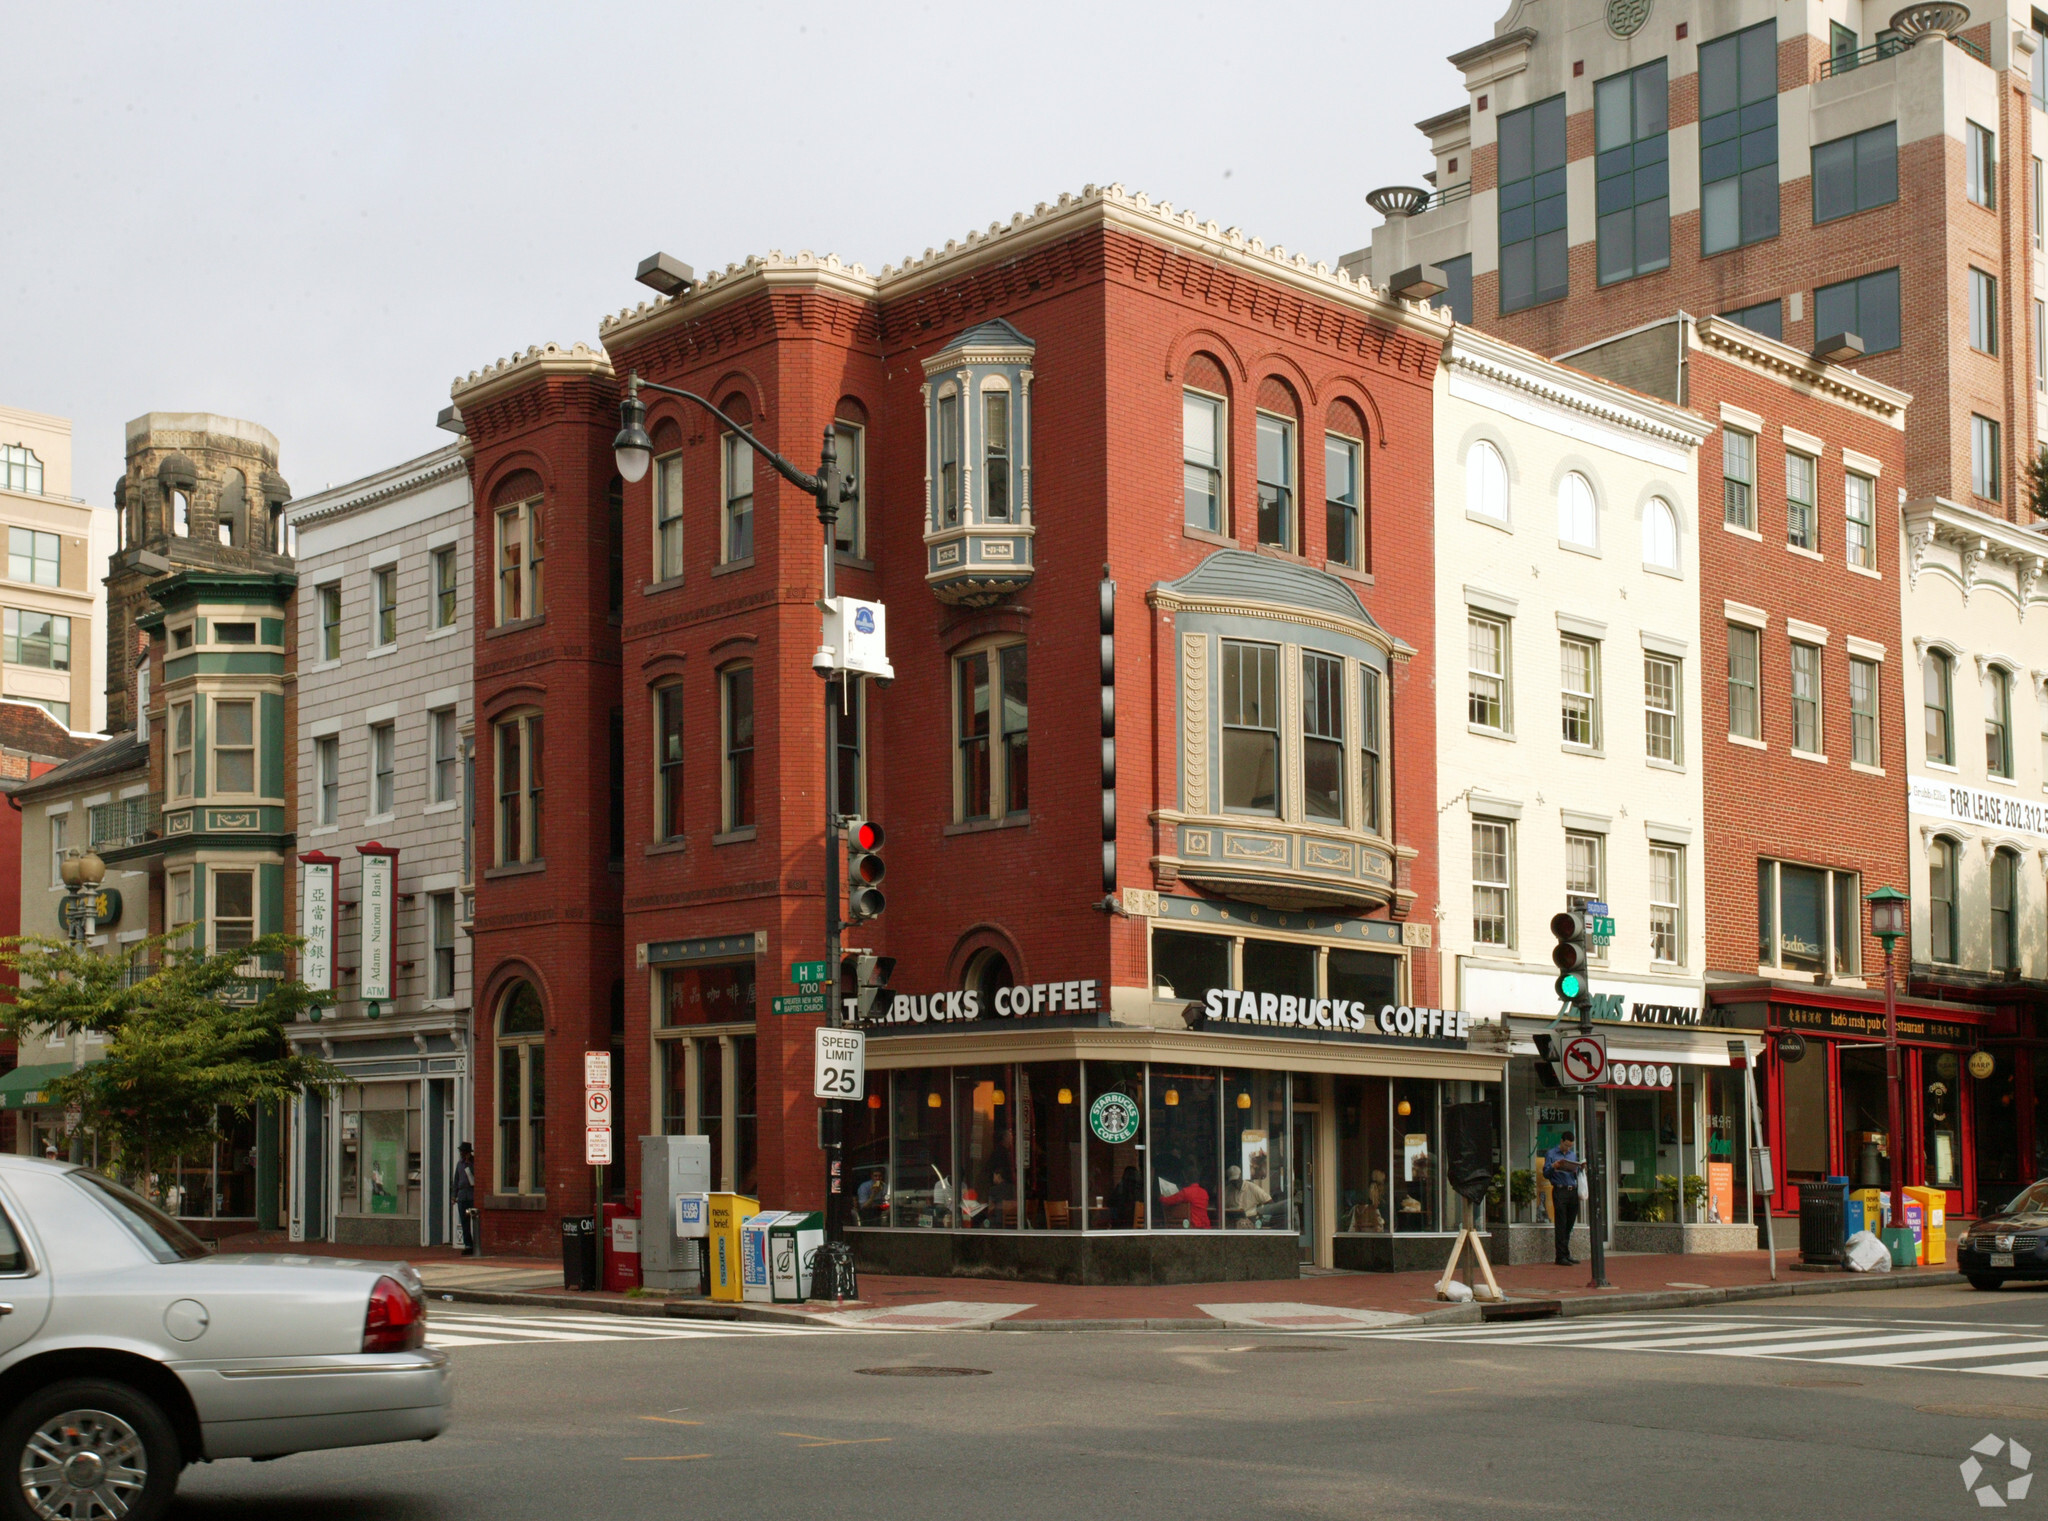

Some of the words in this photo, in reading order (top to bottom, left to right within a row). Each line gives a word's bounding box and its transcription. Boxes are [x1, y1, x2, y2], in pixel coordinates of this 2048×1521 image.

[1950, 788, 1970, 818] FOR
[1972, 793, 2002, 825] LEASE
[371, 873, 381, 897] Bank
[371, 903, 381, 942] National
[1596, 919, 1603, 933] 7
[310, 888, 326, 978] 亞當斯銀行
[1592, 934, 1609, 945] 800
[371, 948, 381, 981] Adams
[799, 965, 808, 981] H
[816, 964, 824, 972] ST
[366, 987, 385, 996] ATM
[800, 983, 818, 994] 700
[783, 997, 801, 1005] GREATER
[784, 1004, 802, 1012] BAPTIST
[803, 1003, 823, 1011] CHURCH
[842, 990, 979, 1023] TBUCKS
[994, 980, 1096, 1016] COFFEE
[1205, 988, 1366, 1030] STARBUCKS
[1379, 1005, 1469, 1038] COFFEE
[1631, 1003, 1700, 1026] NATIONAL
[1866, 1017, 1881, 1035] pub
[1895, 1022, 1925, 1034] estaurant
[822, 1036, 859, 1049] SPEED
[825, 1050, 855, 1061] LIMIT
[823, 1067, 856, 1093] 25
[1092, 1094, 1137, 1117] STARBUCKS
[1097, 1127, 1131, 1142] COFFEE
[683, 1210, 698, 1219] TODAY
[687, 1203, 698, 1211] USA
[712, 1208, 730, 1217] news.
[713, 1218, 729, 1228] brief.
[744, 1232, 752, 1283] APARTMENT
